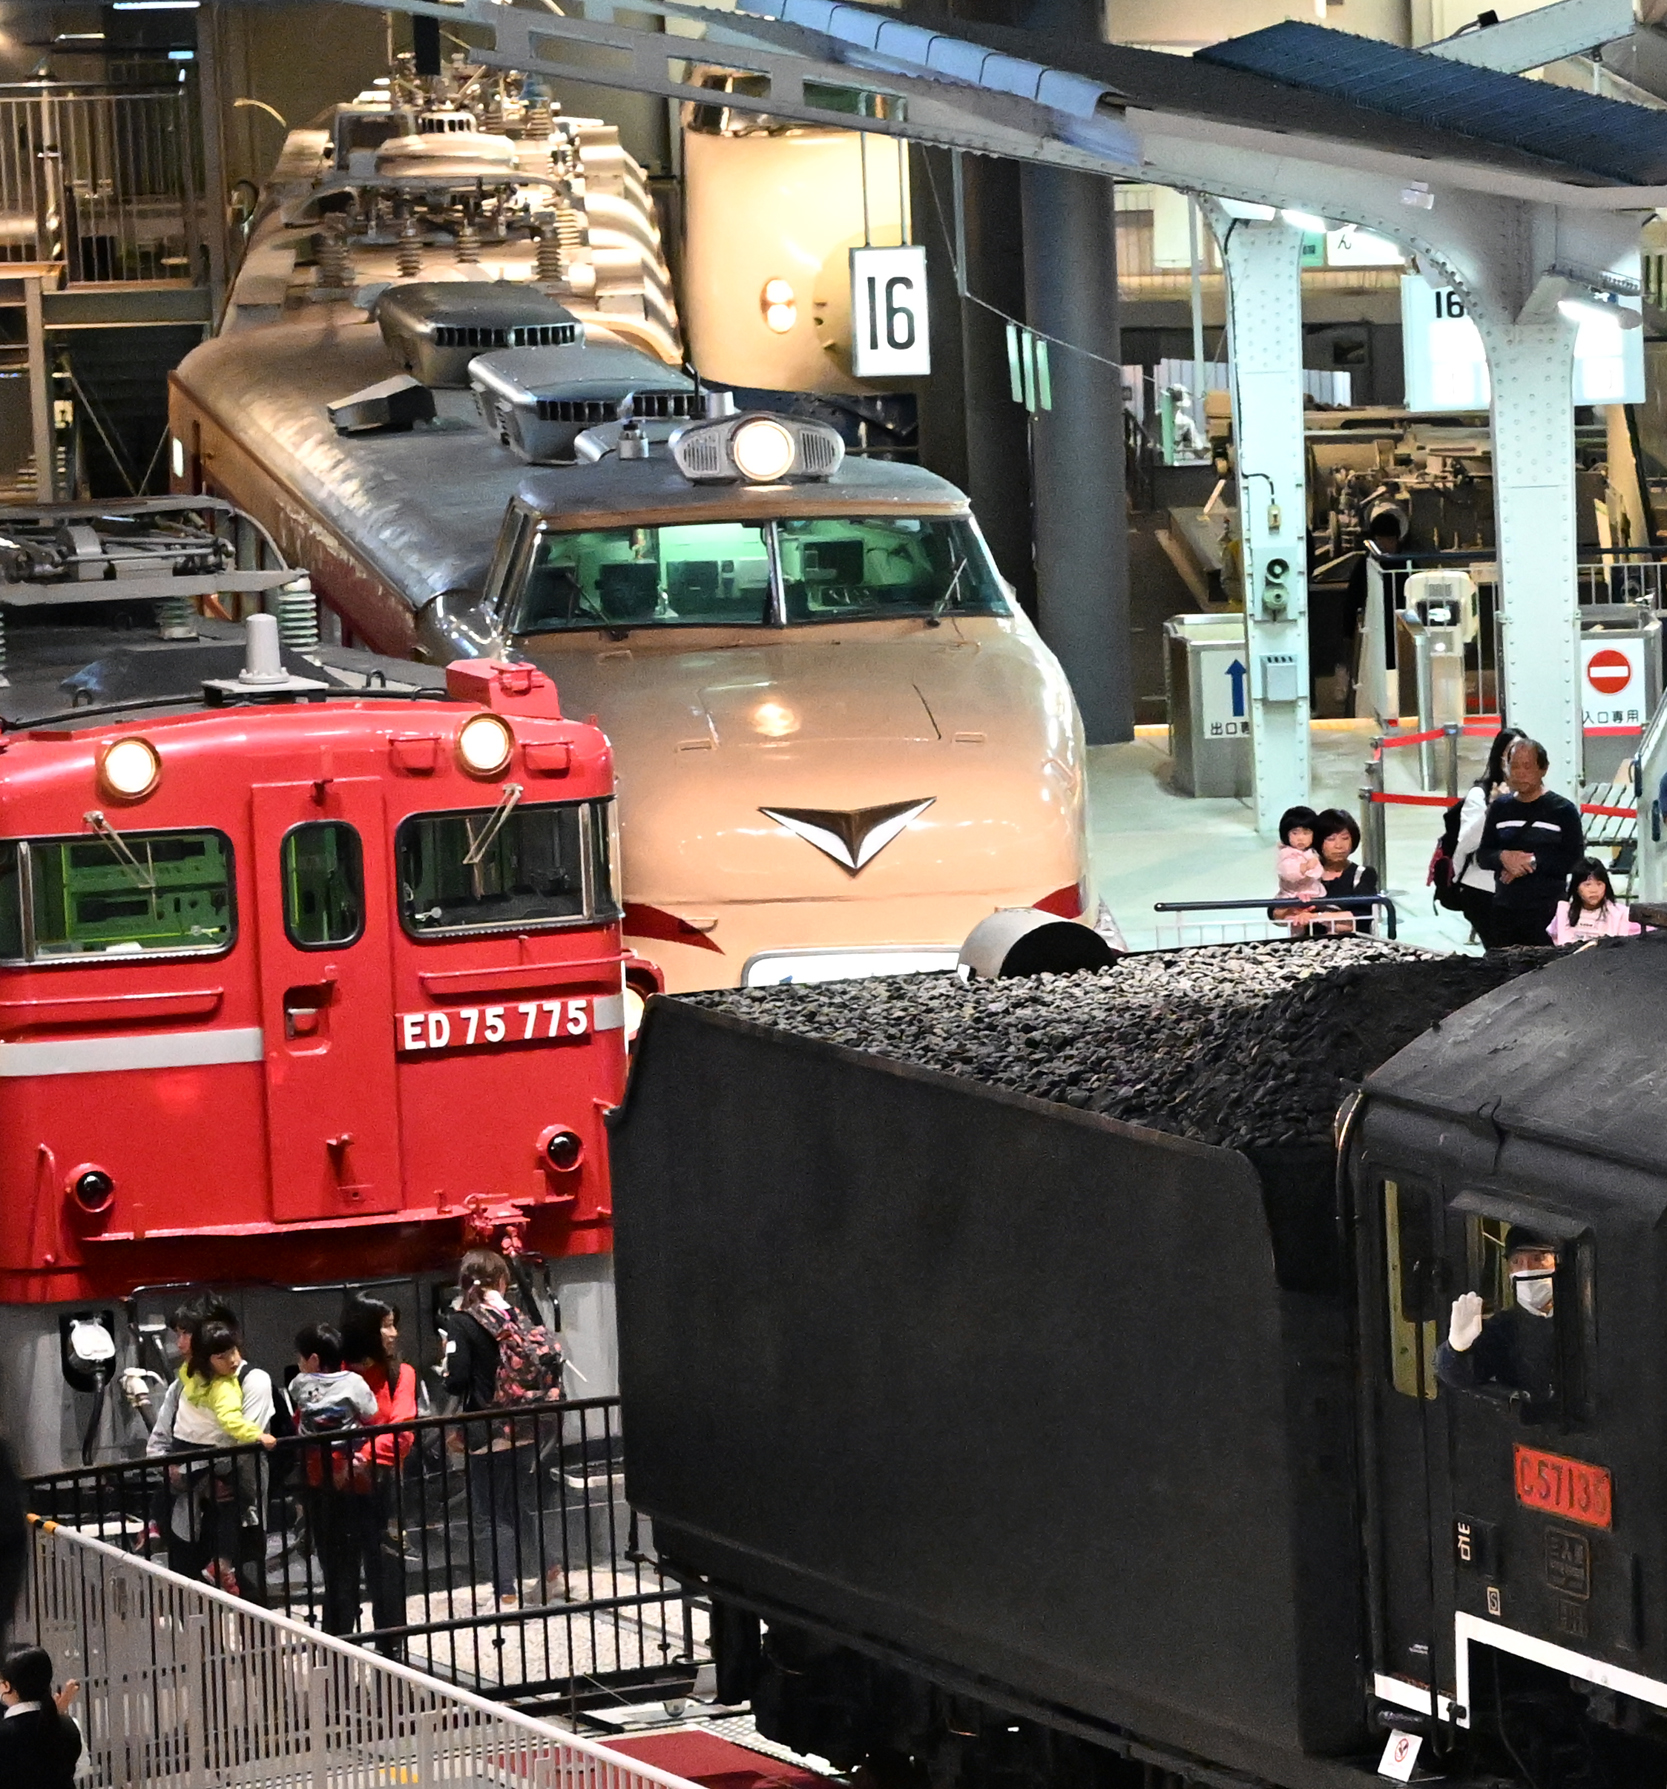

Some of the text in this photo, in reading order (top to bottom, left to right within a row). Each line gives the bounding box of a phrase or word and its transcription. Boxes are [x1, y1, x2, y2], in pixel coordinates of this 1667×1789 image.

[867, 276, 915, 351] 16
[1435, 290, 1464, 319] 16
[1582, 709, 1639, 726] 入口専用
[403, 1000, 587, 1050] ED 75 775
